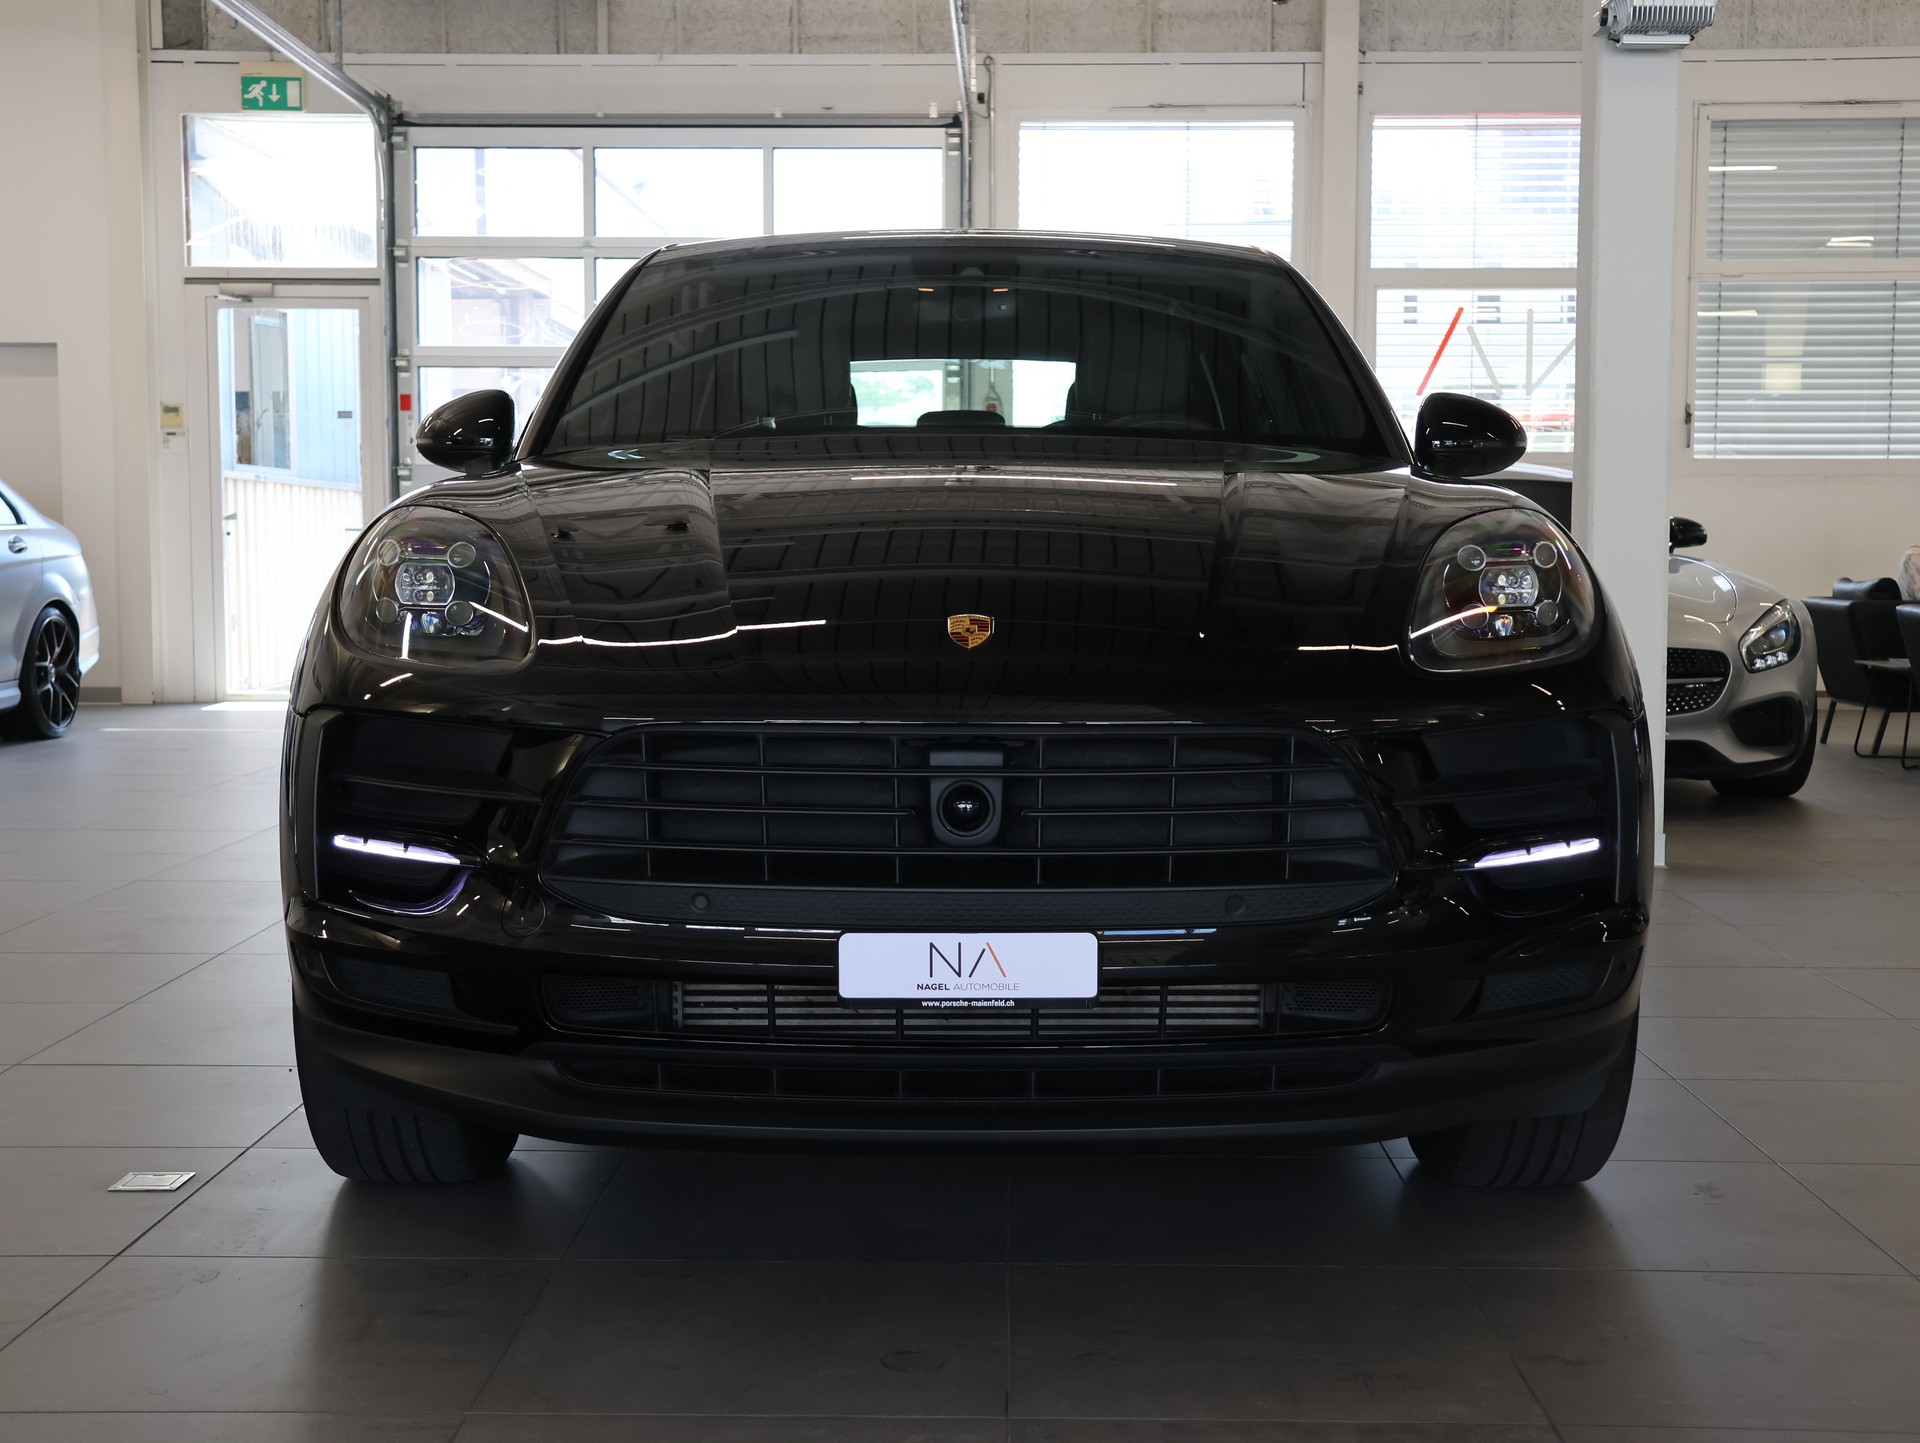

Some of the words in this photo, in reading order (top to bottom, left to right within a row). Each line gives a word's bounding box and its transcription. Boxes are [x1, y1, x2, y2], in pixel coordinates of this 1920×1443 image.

[929, 942, 1006, 978] NA
[916, 983, 950, 991] NAGEL
[953, 983, 1020, 991] AUTOMOBILE
[922, 999, 1015, 1008] www.porsche-maienfeld.ch
